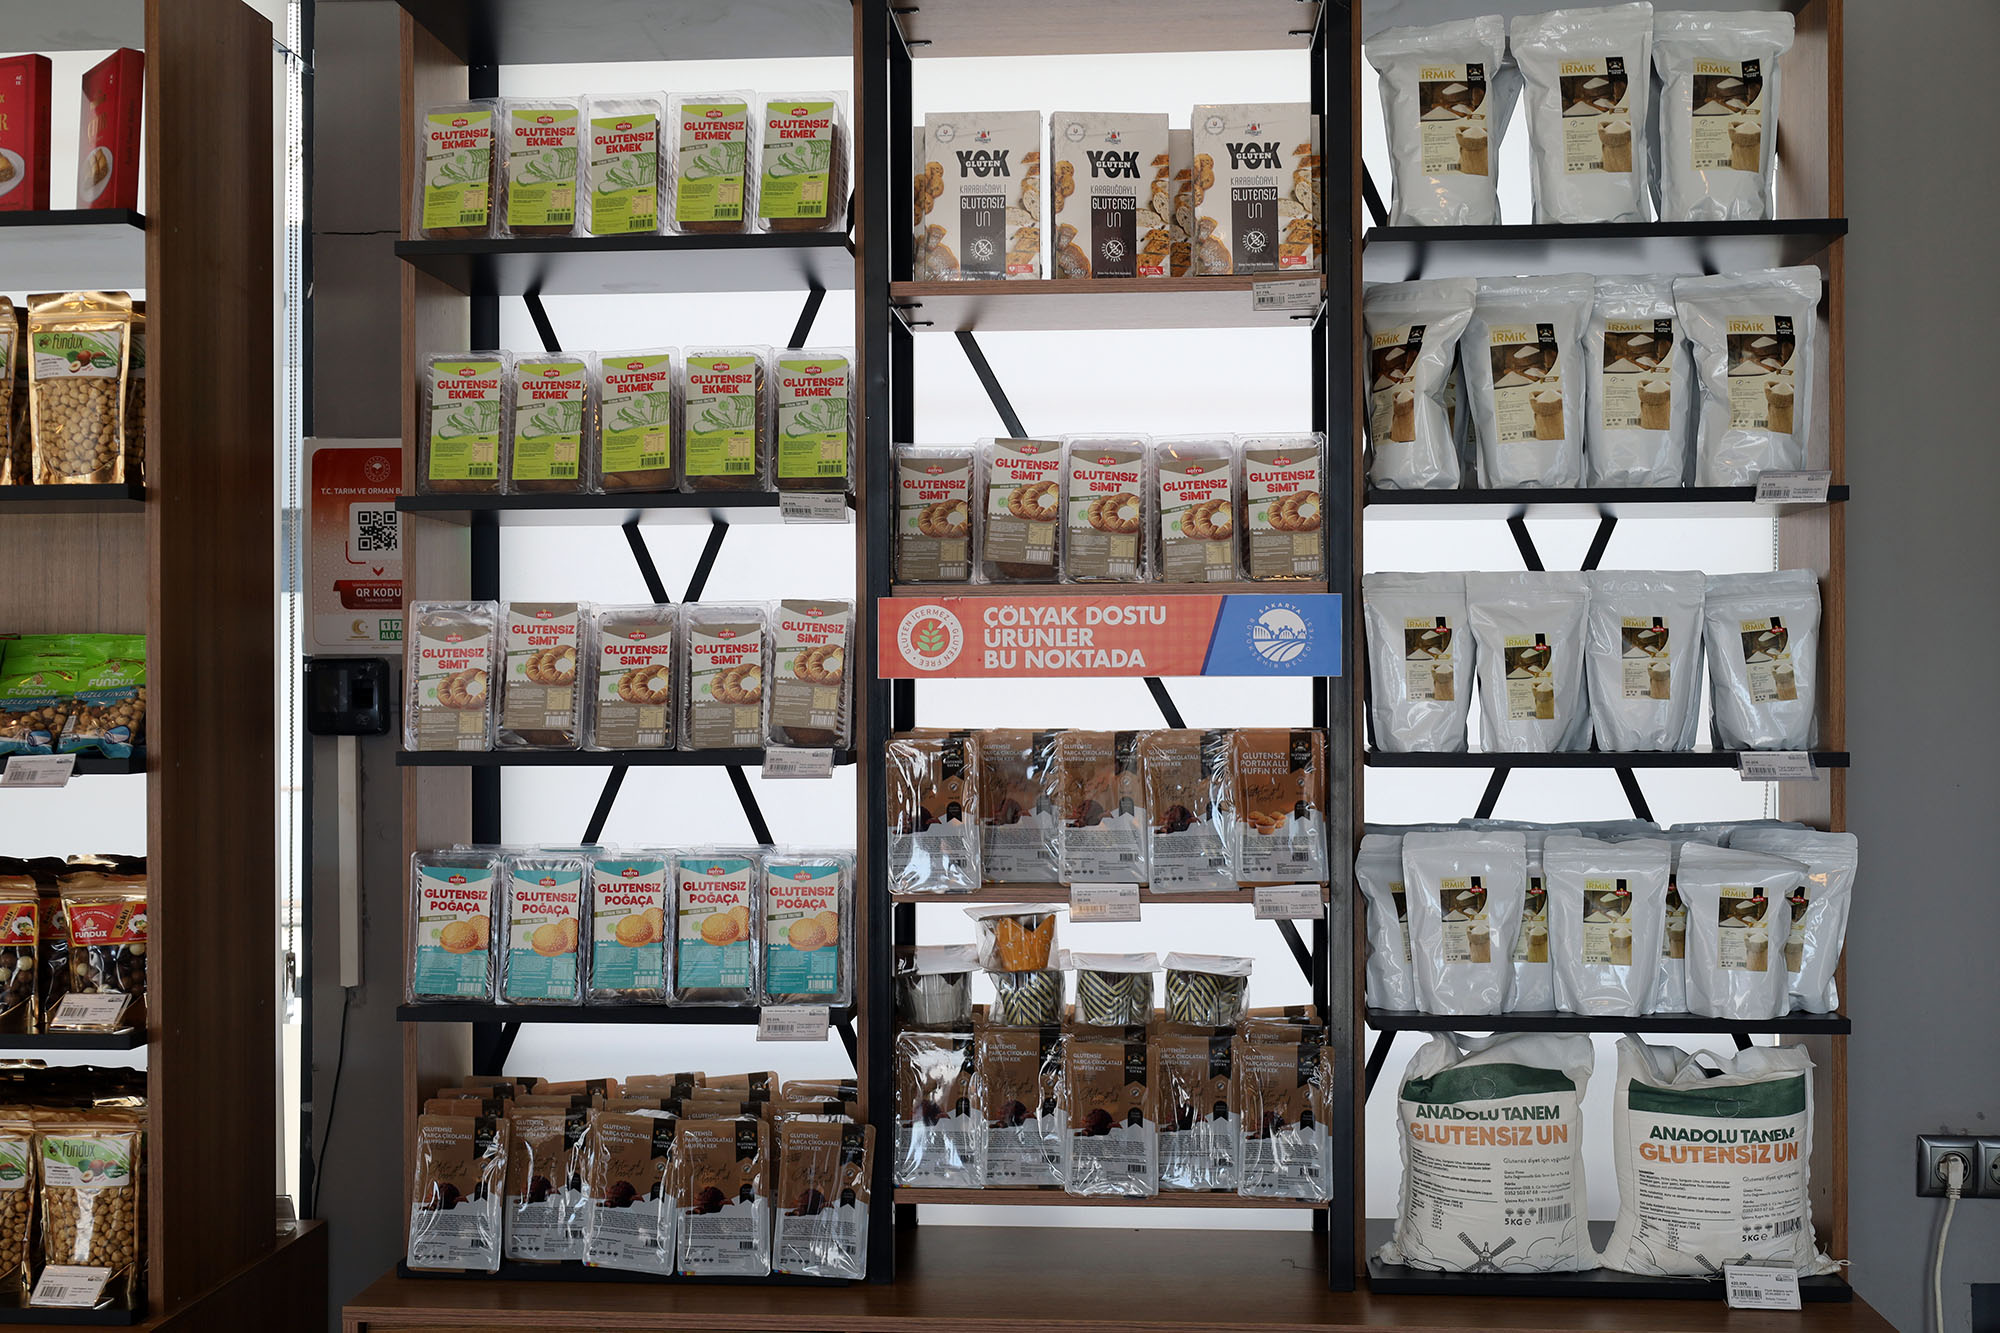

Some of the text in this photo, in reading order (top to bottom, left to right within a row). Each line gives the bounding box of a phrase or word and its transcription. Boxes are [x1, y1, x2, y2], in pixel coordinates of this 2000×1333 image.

[527, 138, 563, 146] EKMEK
[695, 131, 731, 140] EKMEK
[780, 130, 816, 138] EKMEK
[442, 139, 476, 149] EKMEK
[606, 143, 642, 154] EKMEK
[1226, 142, 1282, 169] YOK
[956, 150, 1010, 178] YOK
[1087, 151, 1140, 178] YOK
[1248, 202, 1262, 219] UN
[976, 211, 990, 227] UN
[1106, 211, 1121, 227] UN
[52, 334, 83, 350] fundux
[448, 390, 485, 399] EKMEK
[533, 390, 568, 400] EKMEK
[618, 383, 654, 393] EKMEK
[702, 385, 739, 394] EKMEK
[795, 388, 831, 397] EKMEK
[356, 588, 401, 597] QR KODU
[1259, 602, 1301, 614] SAKARYA
[983, 605, 1166, 629] ÇÖLYAK DOSTU
[901, 621, 912, 655] GLUTEN
[944, 628, 959, 661] GLUTEN
[984, 626, 1094, 647] ÜRÜNLER
[919, 658, 942, 667] FREE
[984, 649, 1146, 668] BU NOKTADA
[1416, 1104, 1560, 1121] ANADOLU TANEM
[1536, 1124, 1568, 1145] UN
[1650, 1125, 1737, 1144] ANADOLU
[63, 1141, 95, 1157] fundux
[1774, 1141, 1799, 1162] UN
